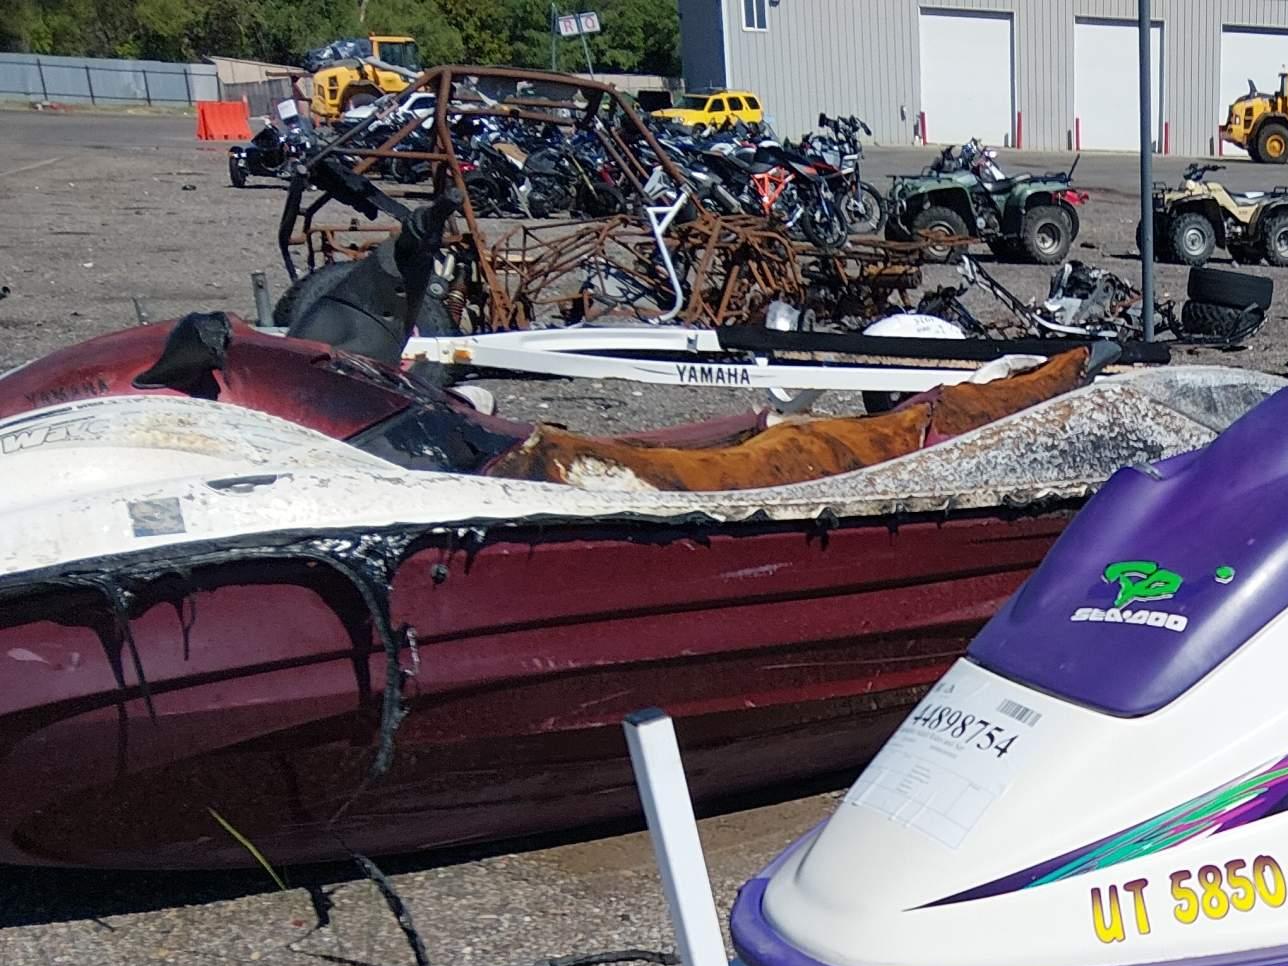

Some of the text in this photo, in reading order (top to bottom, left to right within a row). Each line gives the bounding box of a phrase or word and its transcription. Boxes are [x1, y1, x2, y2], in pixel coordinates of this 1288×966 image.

[676, 364, 750, 385] YAMAHA
[912, 703, 1020, 759] 44898754
[1091, 878, 1151, 944] UT
[1169, 855, 1288, 924] 5850
